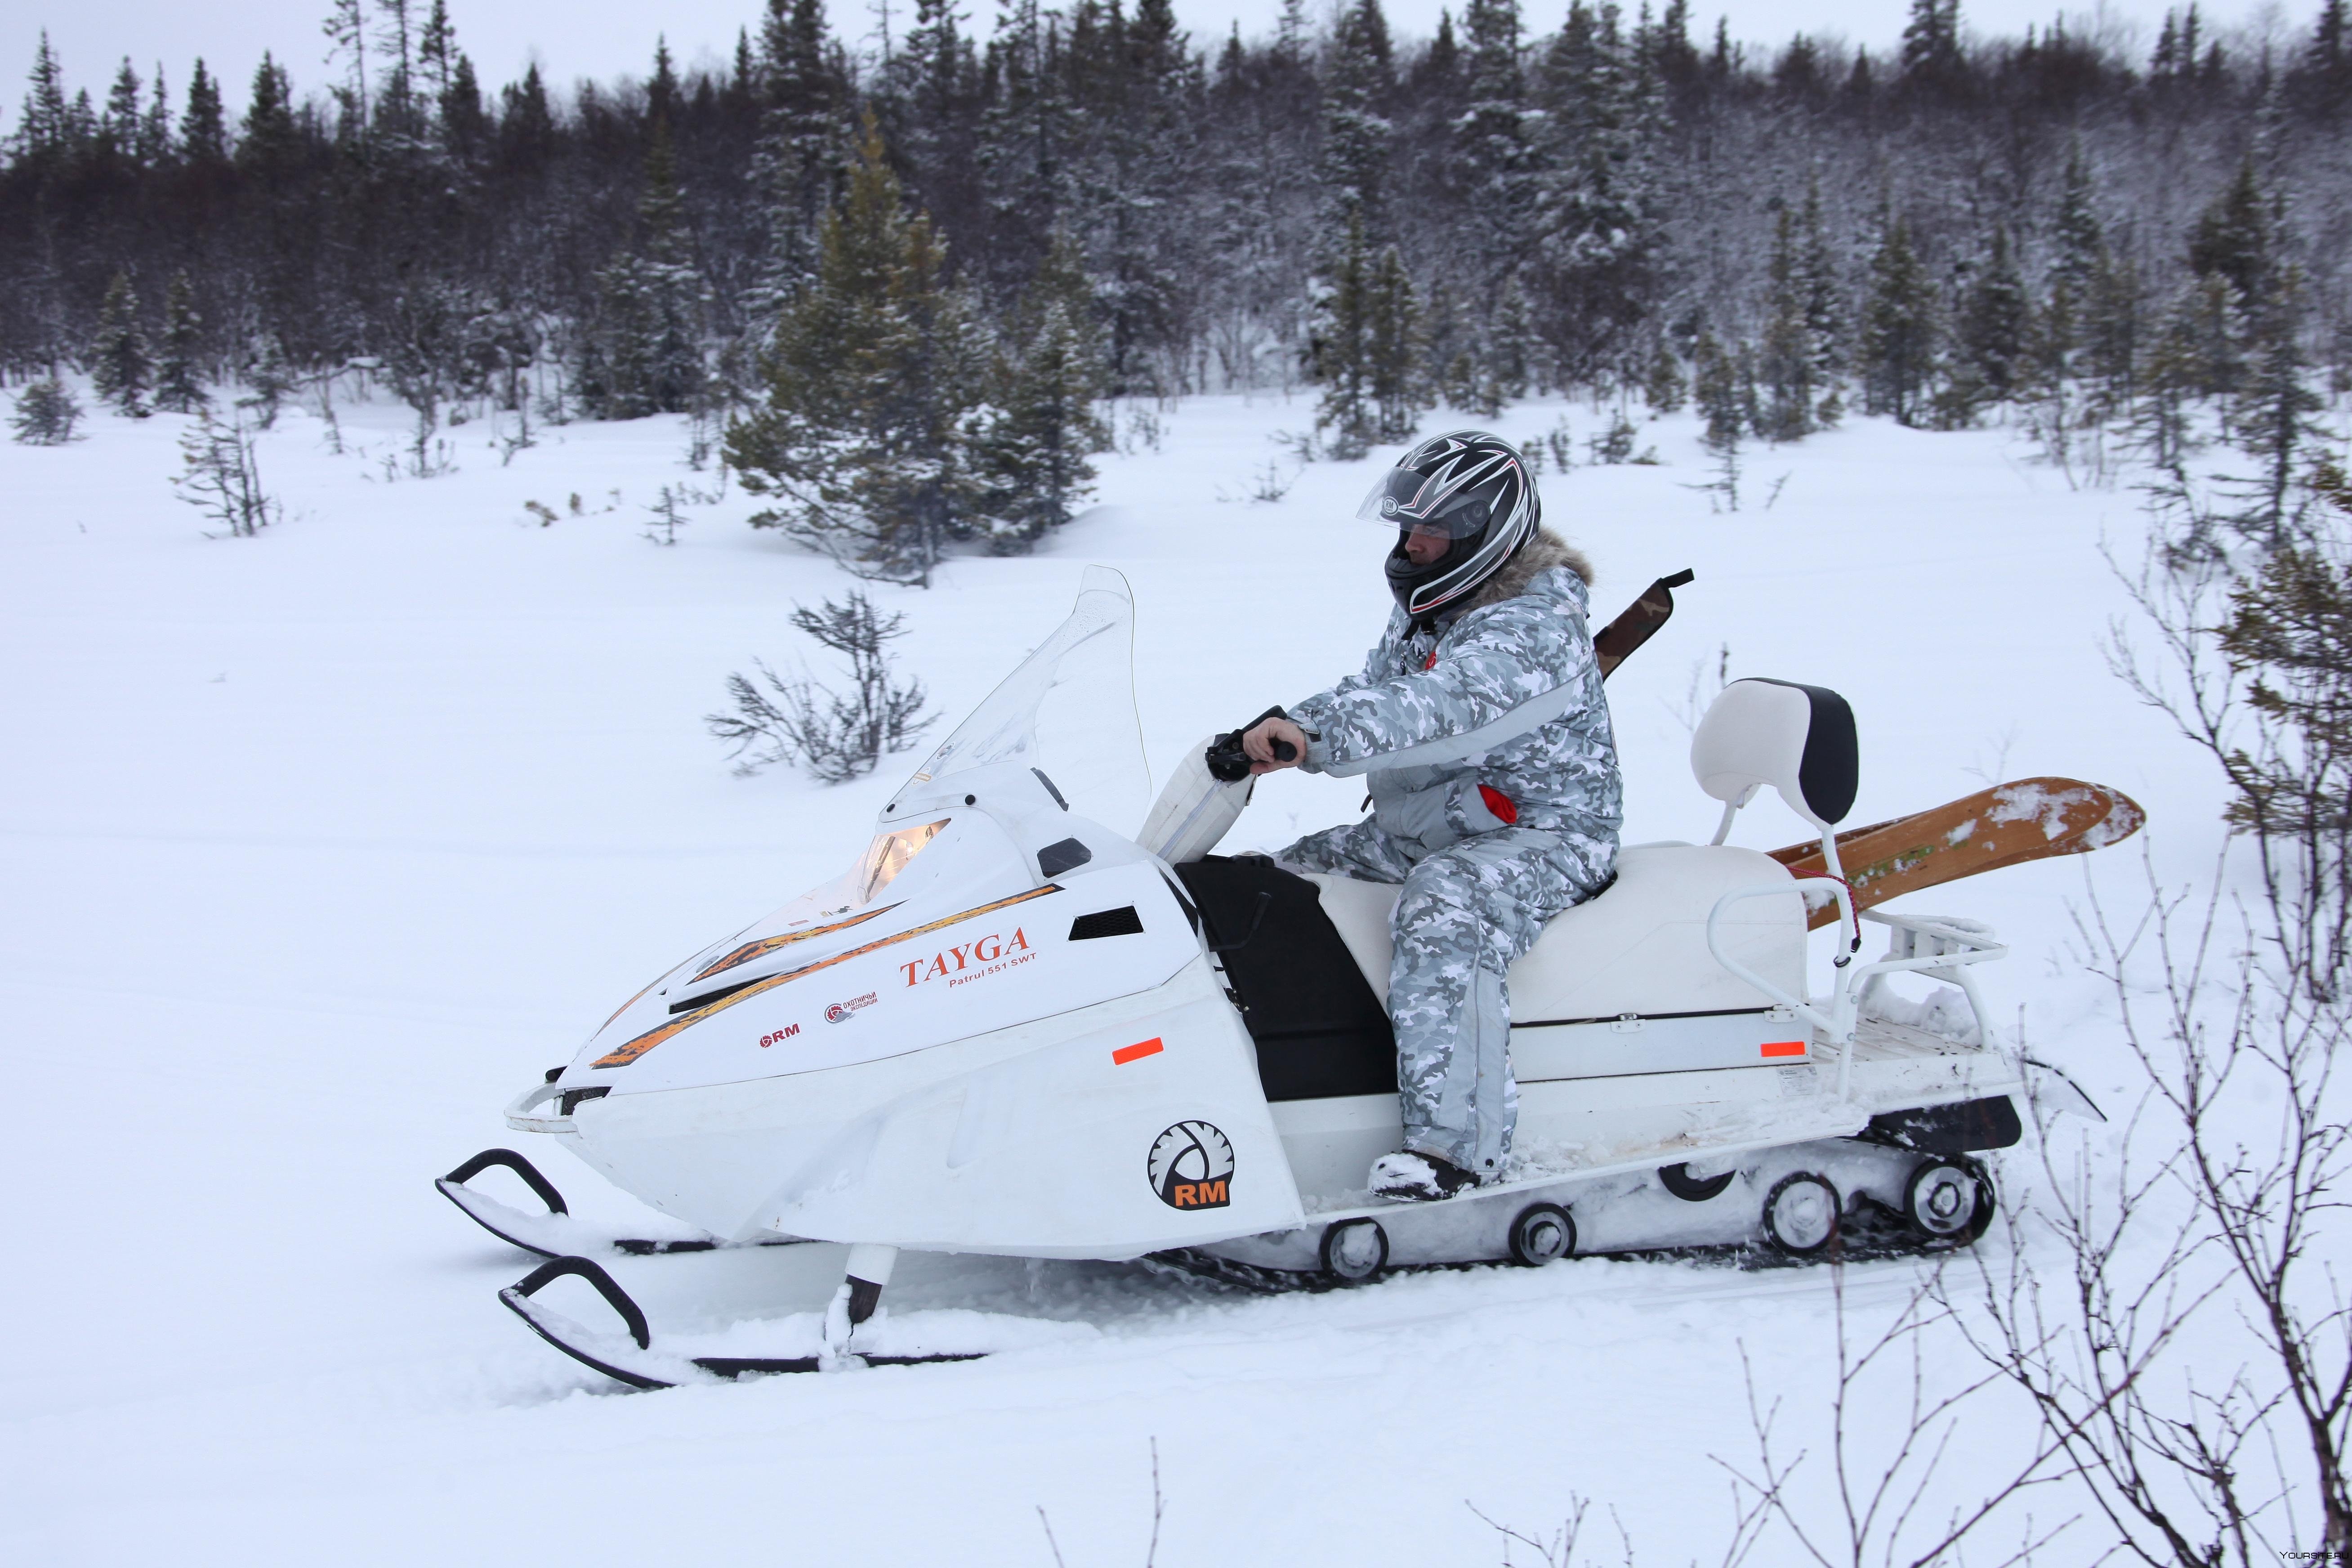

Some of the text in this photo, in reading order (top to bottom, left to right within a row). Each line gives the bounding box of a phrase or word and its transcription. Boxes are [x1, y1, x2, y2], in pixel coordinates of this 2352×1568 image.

[1385, 500, 1393, 509] RM
[900, 926, 1030, 988] TAYGA
[949, 952, 1037, 988] Patrul 551 SWT
[843, 991, 877, 1009] ОХОТНИЧЬИ
[850, 997, 879, 1012] ЭКСПЕДИЦИИ
[772, 1023, 800, 1043] RM
[1174, 1180, 1227, 1206] RM
